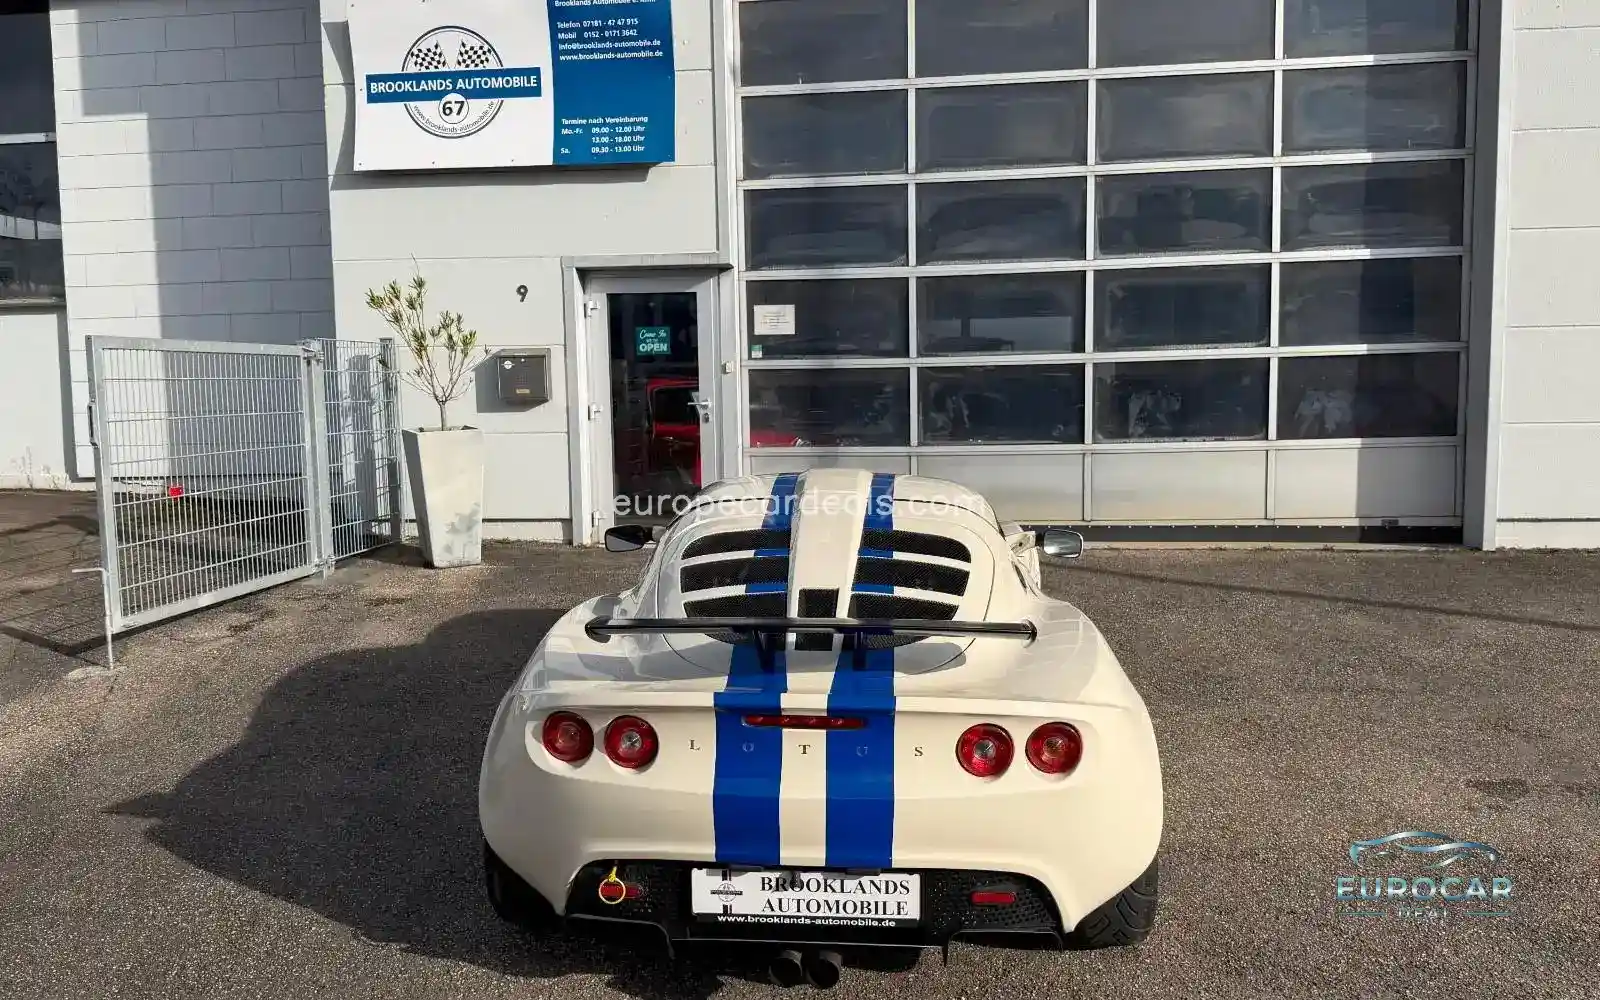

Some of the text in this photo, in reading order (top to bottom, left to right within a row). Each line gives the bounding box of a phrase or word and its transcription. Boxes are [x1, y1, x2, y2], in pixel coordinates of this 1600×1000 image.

[560, 50, 663, 60] www.brooklands-automobile.de
[370, 75, 538, 94] BROOKLANDS AUTOMOBILE
[414, 100, 494, 132] www.brooklands-automobile.de
[442, 100, 464, 116] 67
[516, 285, 528, 302] 9
[640, 344, 668, 352] OPEN
[760, 876, 910, 895] BROOKLANDS
[762, 898, 909, 916] AUTOMOBILE
[717, 915, 896, 928] www.brooklands-automobile.de
